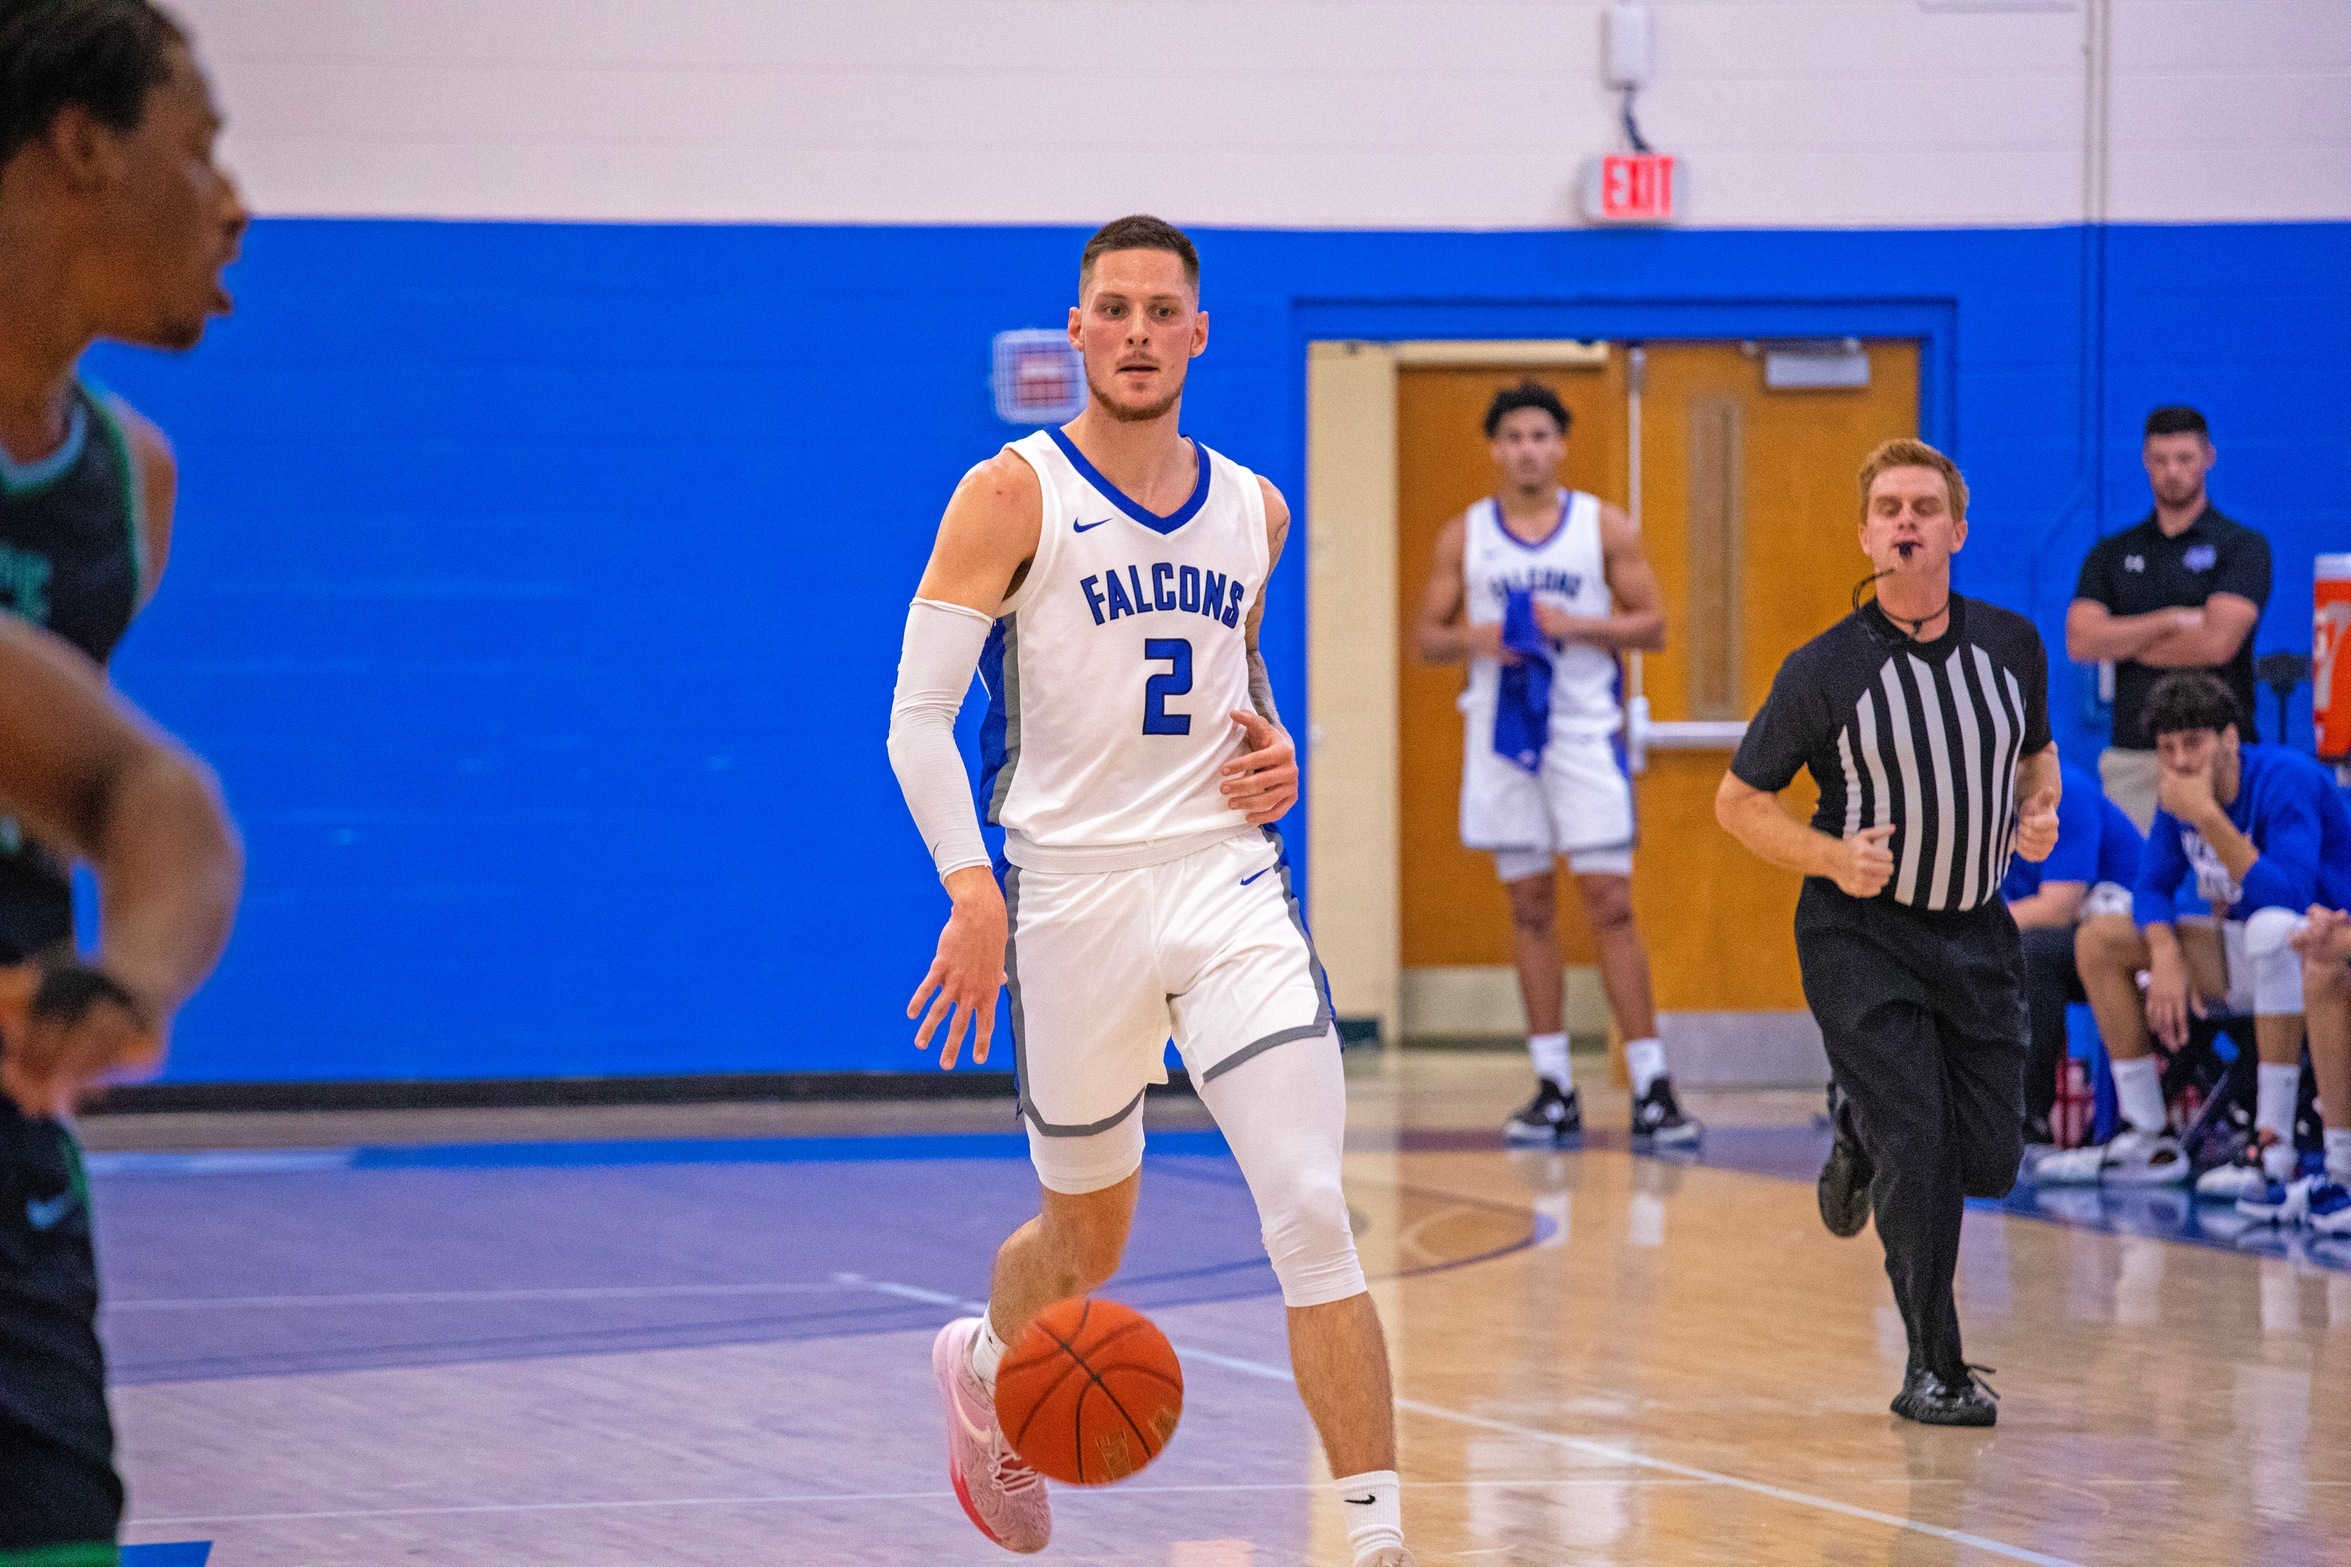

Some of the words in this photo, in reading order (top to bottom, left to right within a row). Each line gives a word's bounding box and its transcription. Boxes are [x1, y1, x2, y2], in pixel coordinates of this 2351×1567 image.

[1602, 155, 1674, 218] EXIT
[1080, 562, 1245, 629] FALCONS
[1142, 638, 1193, 735] 2
